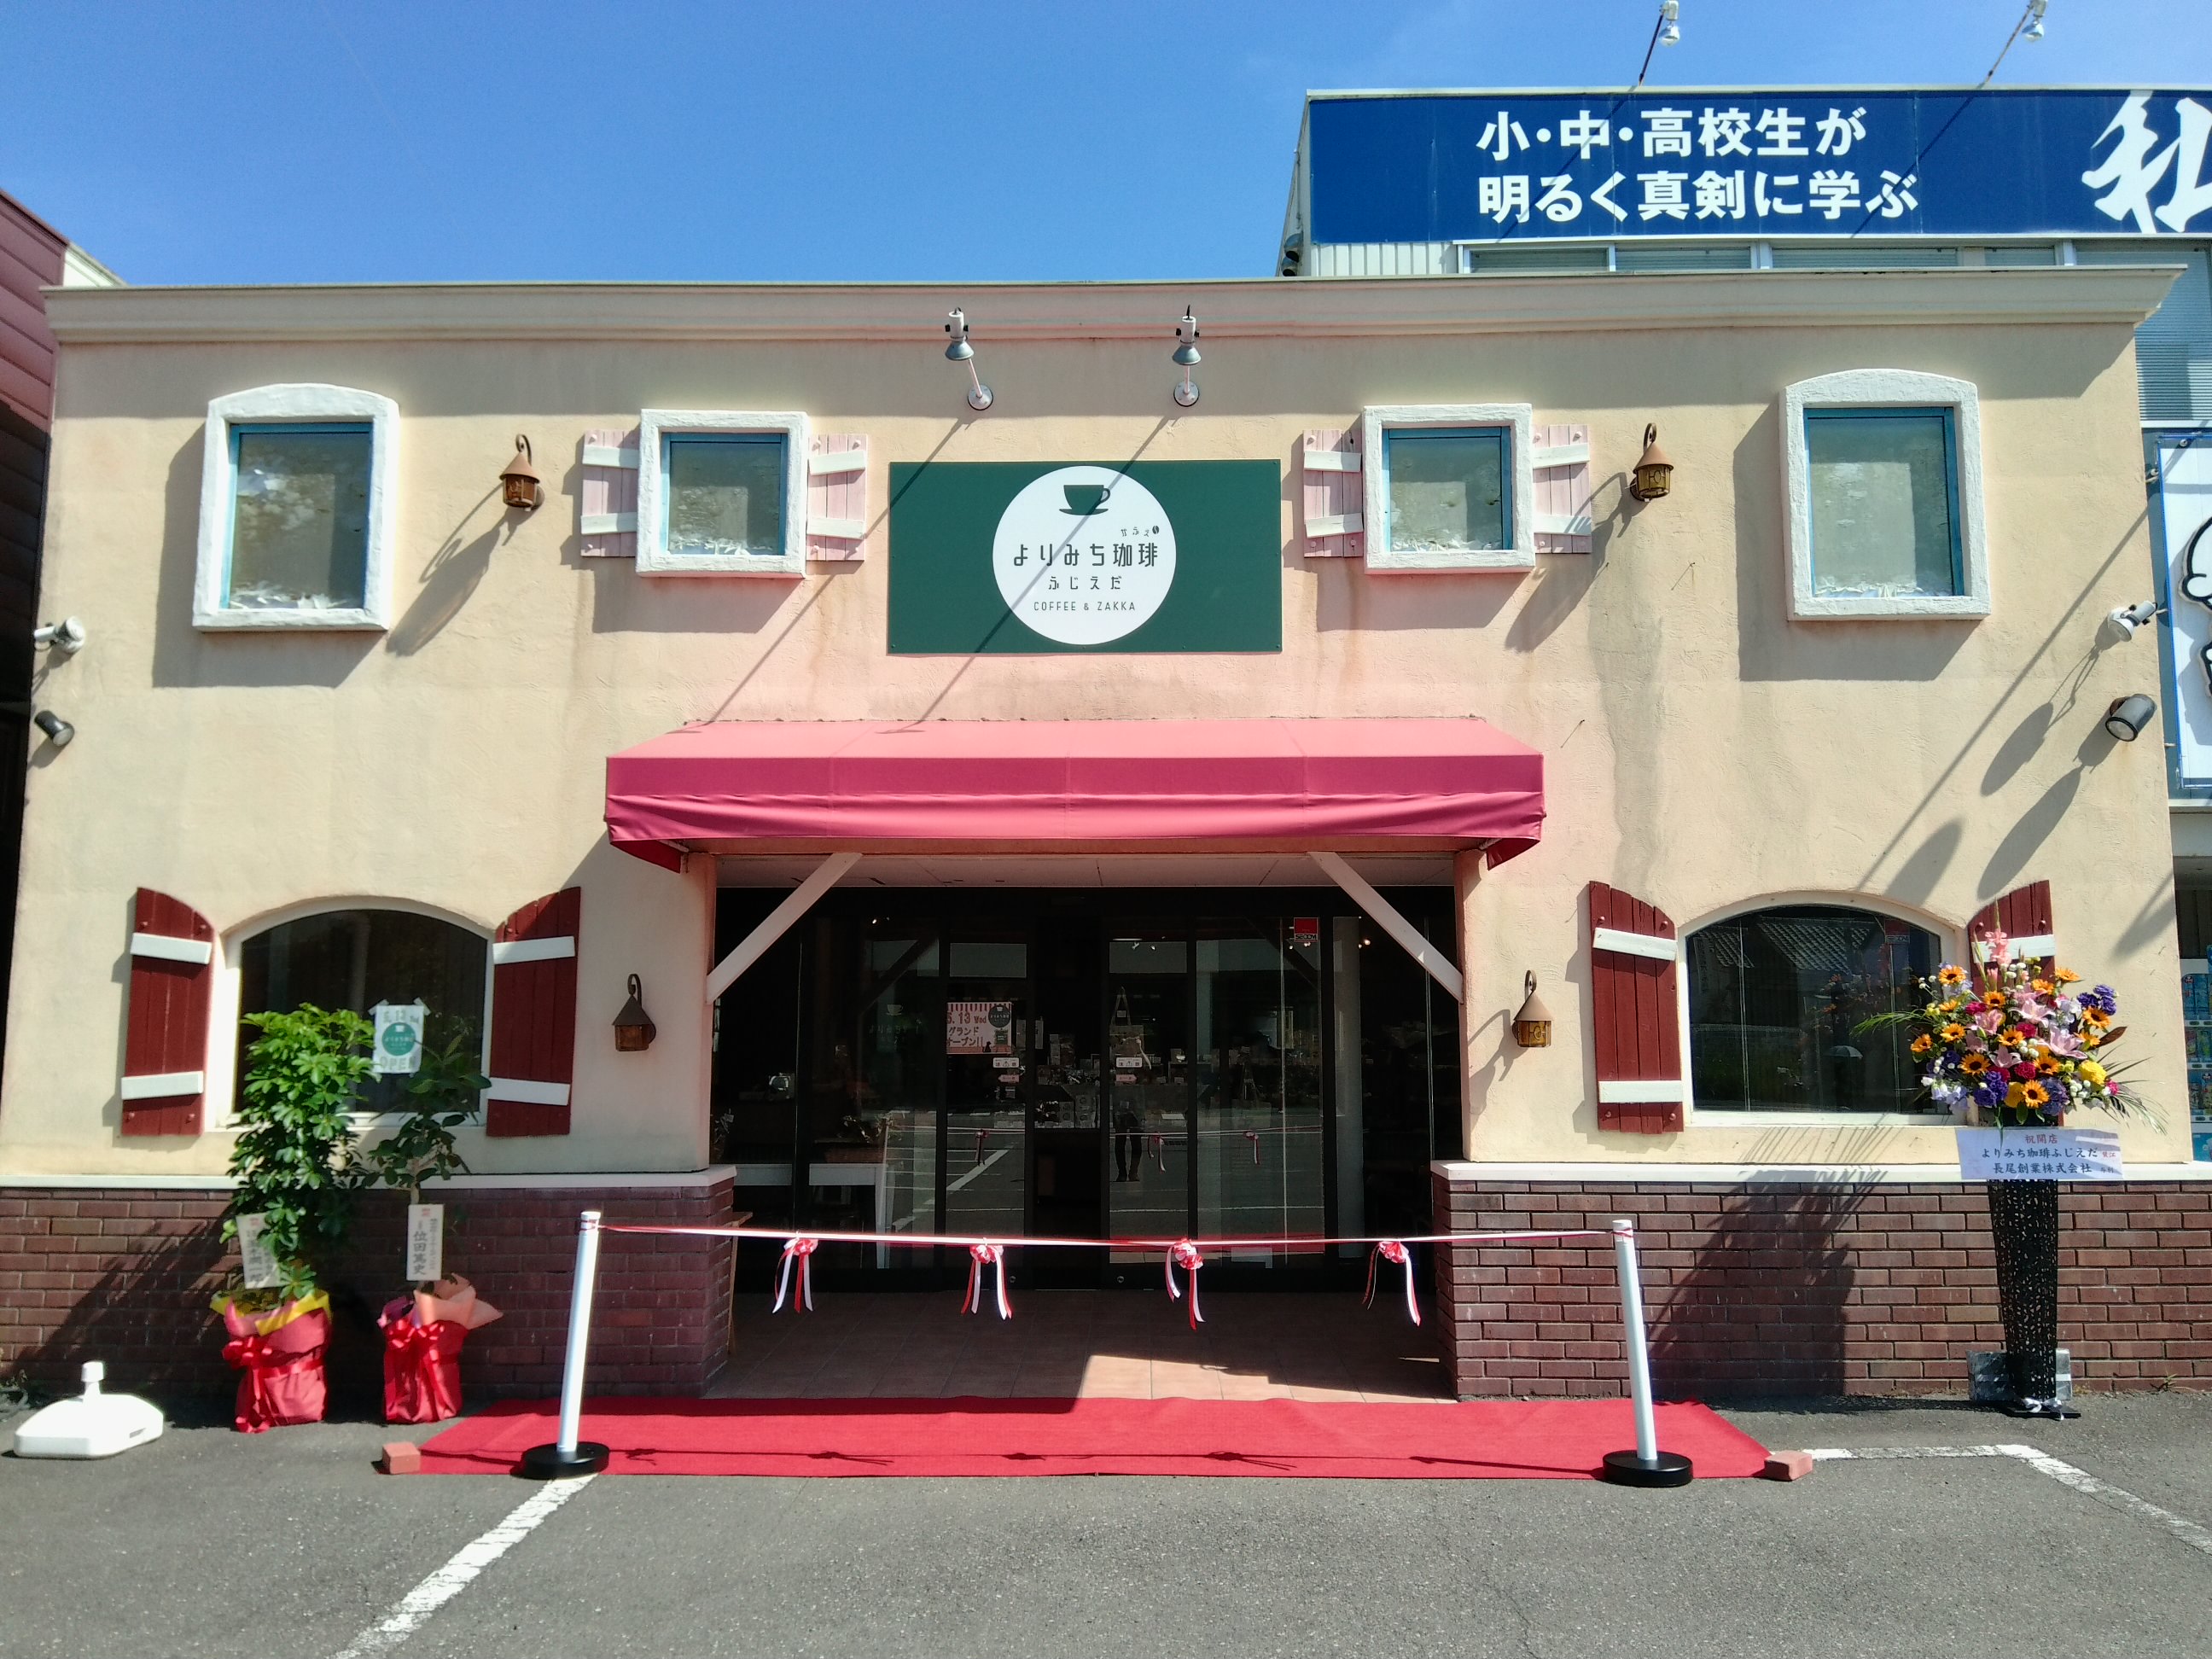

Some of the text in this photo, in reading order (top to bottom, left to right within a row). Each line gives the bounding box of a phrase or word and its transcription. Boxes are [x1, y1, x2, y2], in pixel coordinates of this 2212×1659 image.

[1476, 106, 1867, 162] 小・中・高校生が
[1477, 170, 1918, 224] 明るく真剣に学ぶ
[1013, 542, 1159, 568] よりみち珈琲
[1048, 576, 1122, 591] ふじえだ
[1033, 601, 1136, 611] COFFEE & ZAKKA
[949, 1026, 979, 1036] グランド
[2025, 1133, 2058, 1144] 祝開店
[1982, 1147, 2098, 1159] よりみち珈琲ふじえだ
[1993, 1162, 2093, 1174] 長尾創業株式会社
